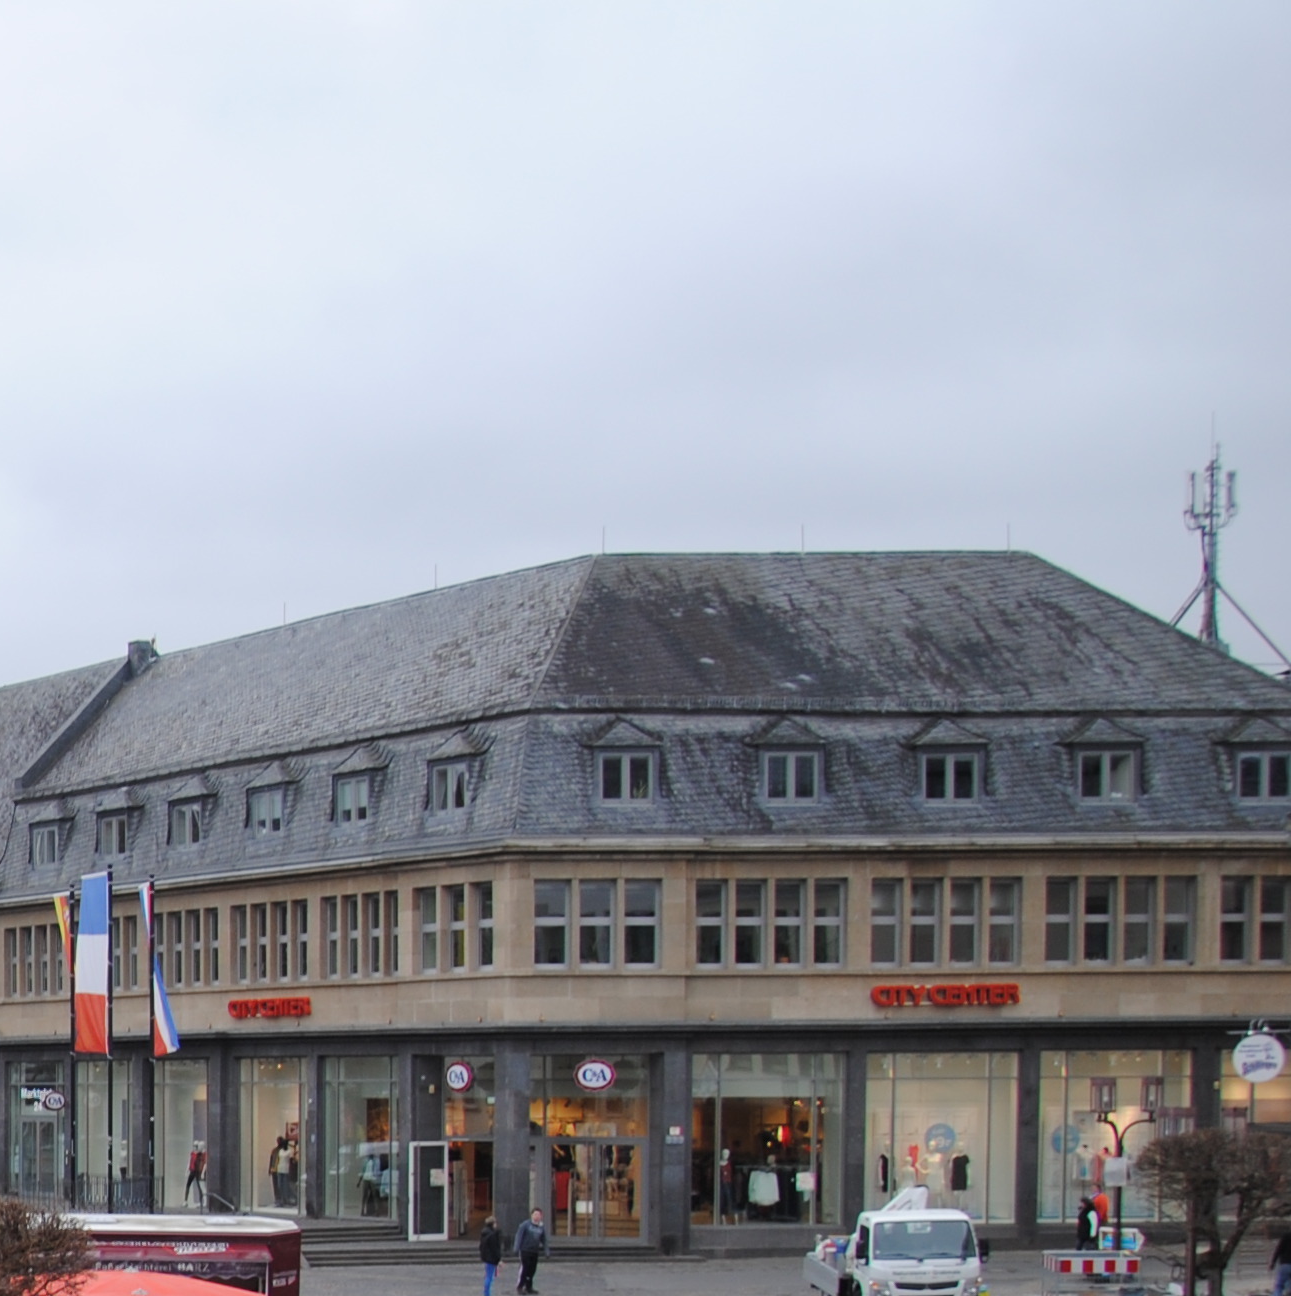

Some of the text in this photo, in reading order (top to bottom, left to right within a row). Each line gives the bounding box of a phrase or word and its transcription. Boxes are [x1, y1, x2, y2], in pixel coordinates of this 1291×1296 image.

[871, 983, 1020, 1006] CITY CENTER
[449, 1070, 464, 1084] C&A
[583, 1069, 607, 1083] C&A
